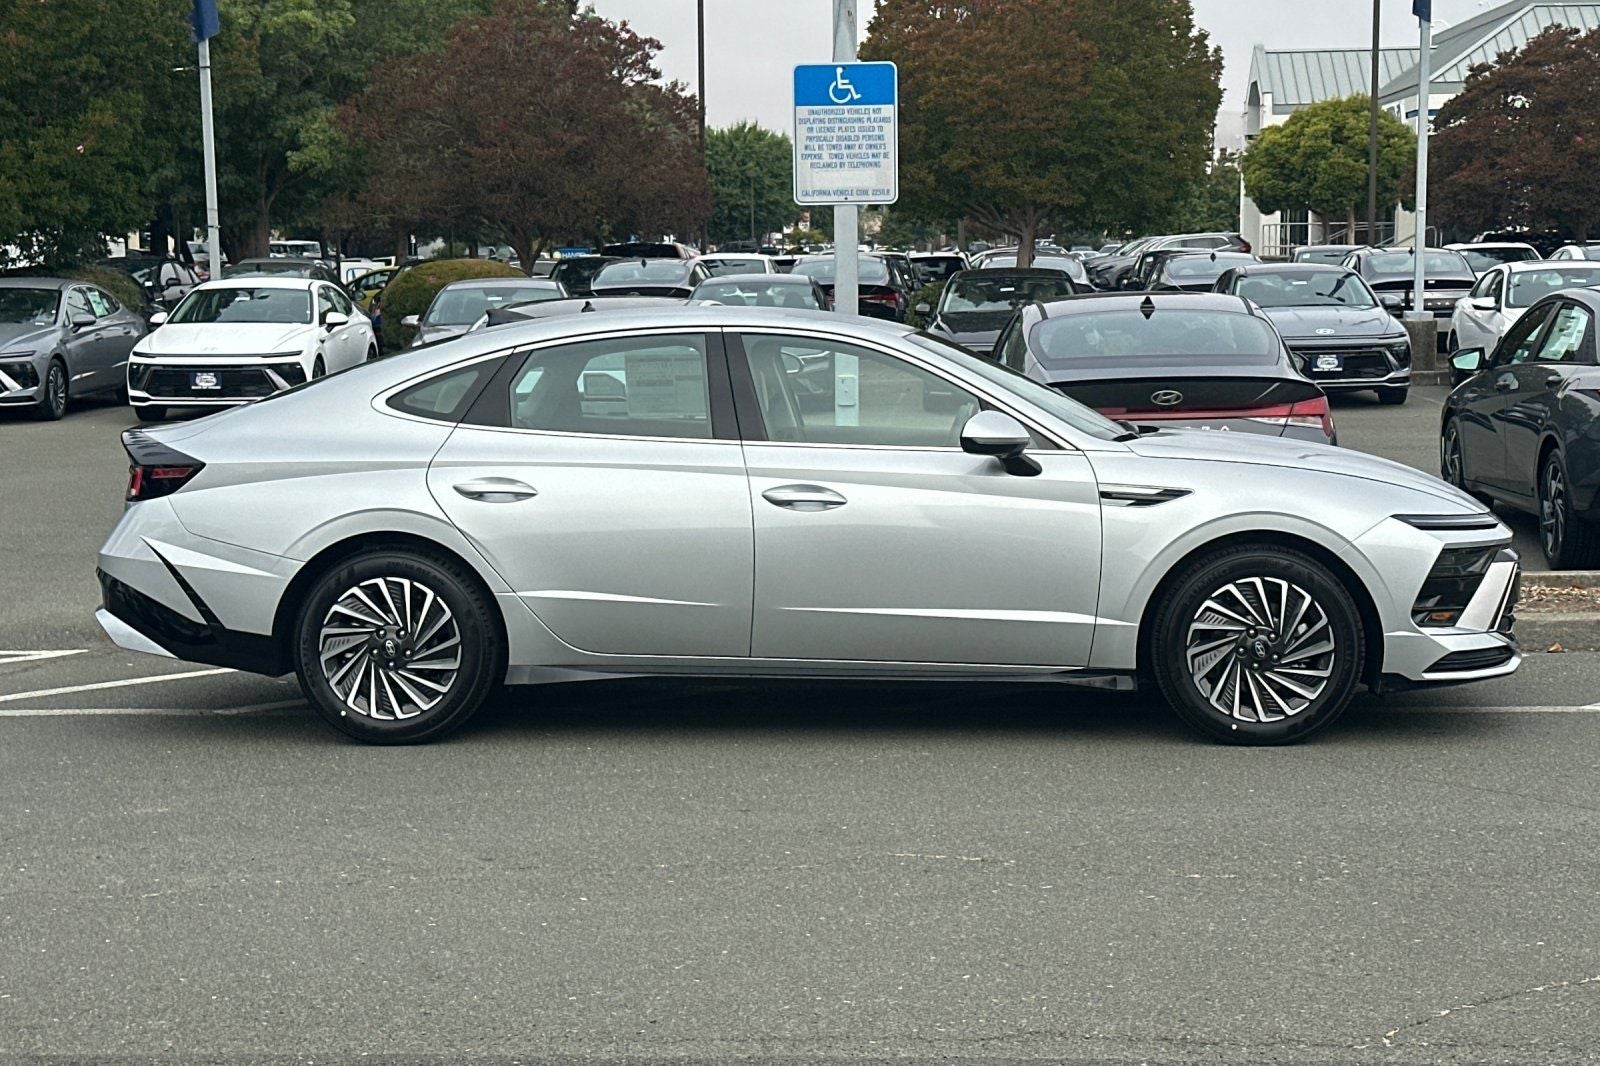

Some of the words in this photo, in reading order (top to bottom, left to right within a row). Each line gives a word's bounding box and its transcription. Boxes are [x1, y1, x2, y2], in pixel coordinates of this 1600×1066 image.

[847, 107, 871, 115] VEHICLES
[872, 107, 882, 115] NOT
[828, 116, 865, 124] DISTINGUISHING
[838, 125, 856, 133] PLATES
[836, 134, 860, 142] DISABLED
[826, 143, 843, 151] TOWED
[883, 151, 890, 159] BE
[801, 189, 831, 197] CALIFORNIA
[856, 188, 869, 196] CODE
